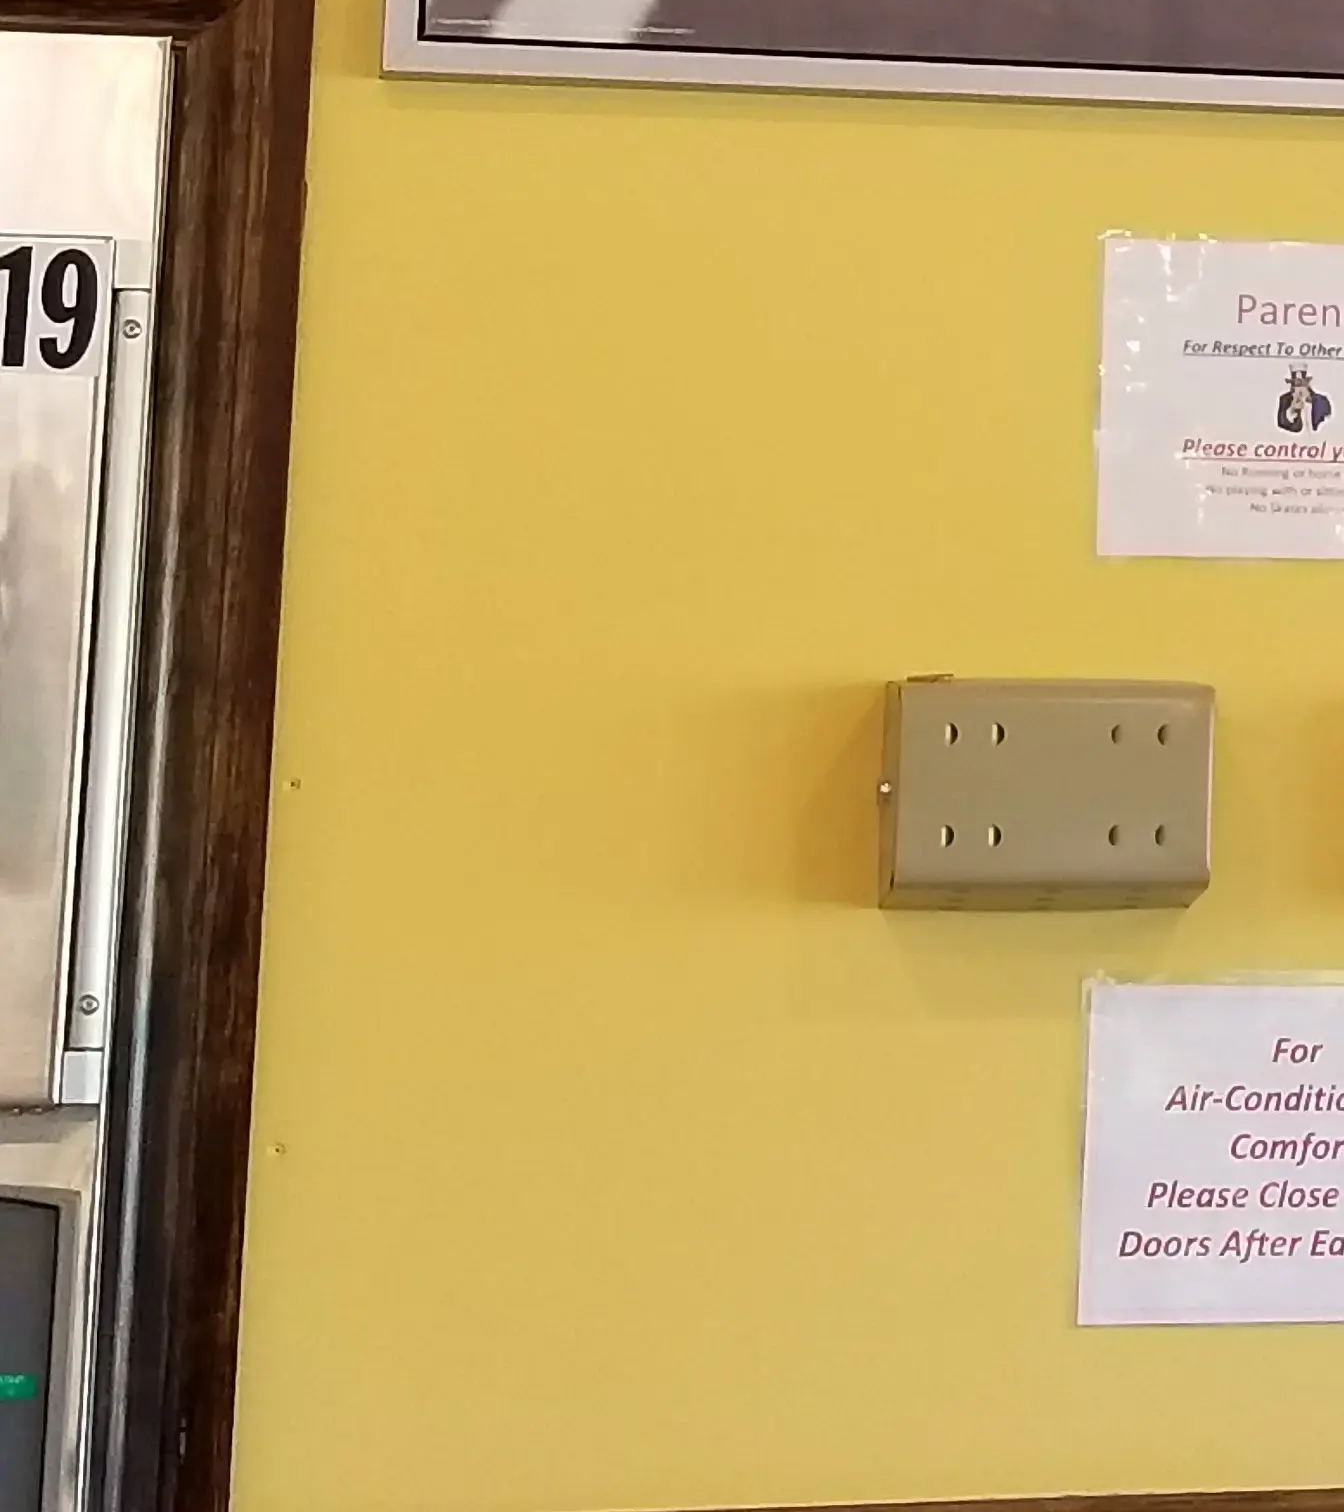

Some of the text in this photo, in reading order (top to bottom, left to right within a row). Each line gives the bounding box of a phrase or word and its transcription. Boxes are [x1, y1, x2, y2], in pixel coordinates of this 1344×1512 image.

[0, 245, 98, 370] 19
[1183, 339, 1208, 354] For
[1211, 340, 1272, 357] Respect
[1277, 341, 1294, 356] To
[1299, 342, 1342, 358] Other
[1182, 438, 1248, 458] Please
[1254, 441, 1327, 459] control
[1272, 1037, 1323, 1064] For
[1146, 1180, 1249, 1209] Please
[1258, 1180, 1340, 1209] Close
[1118, 1230, 1211, 1258] Doors
[1218, 1228, 1302, 1264] After
